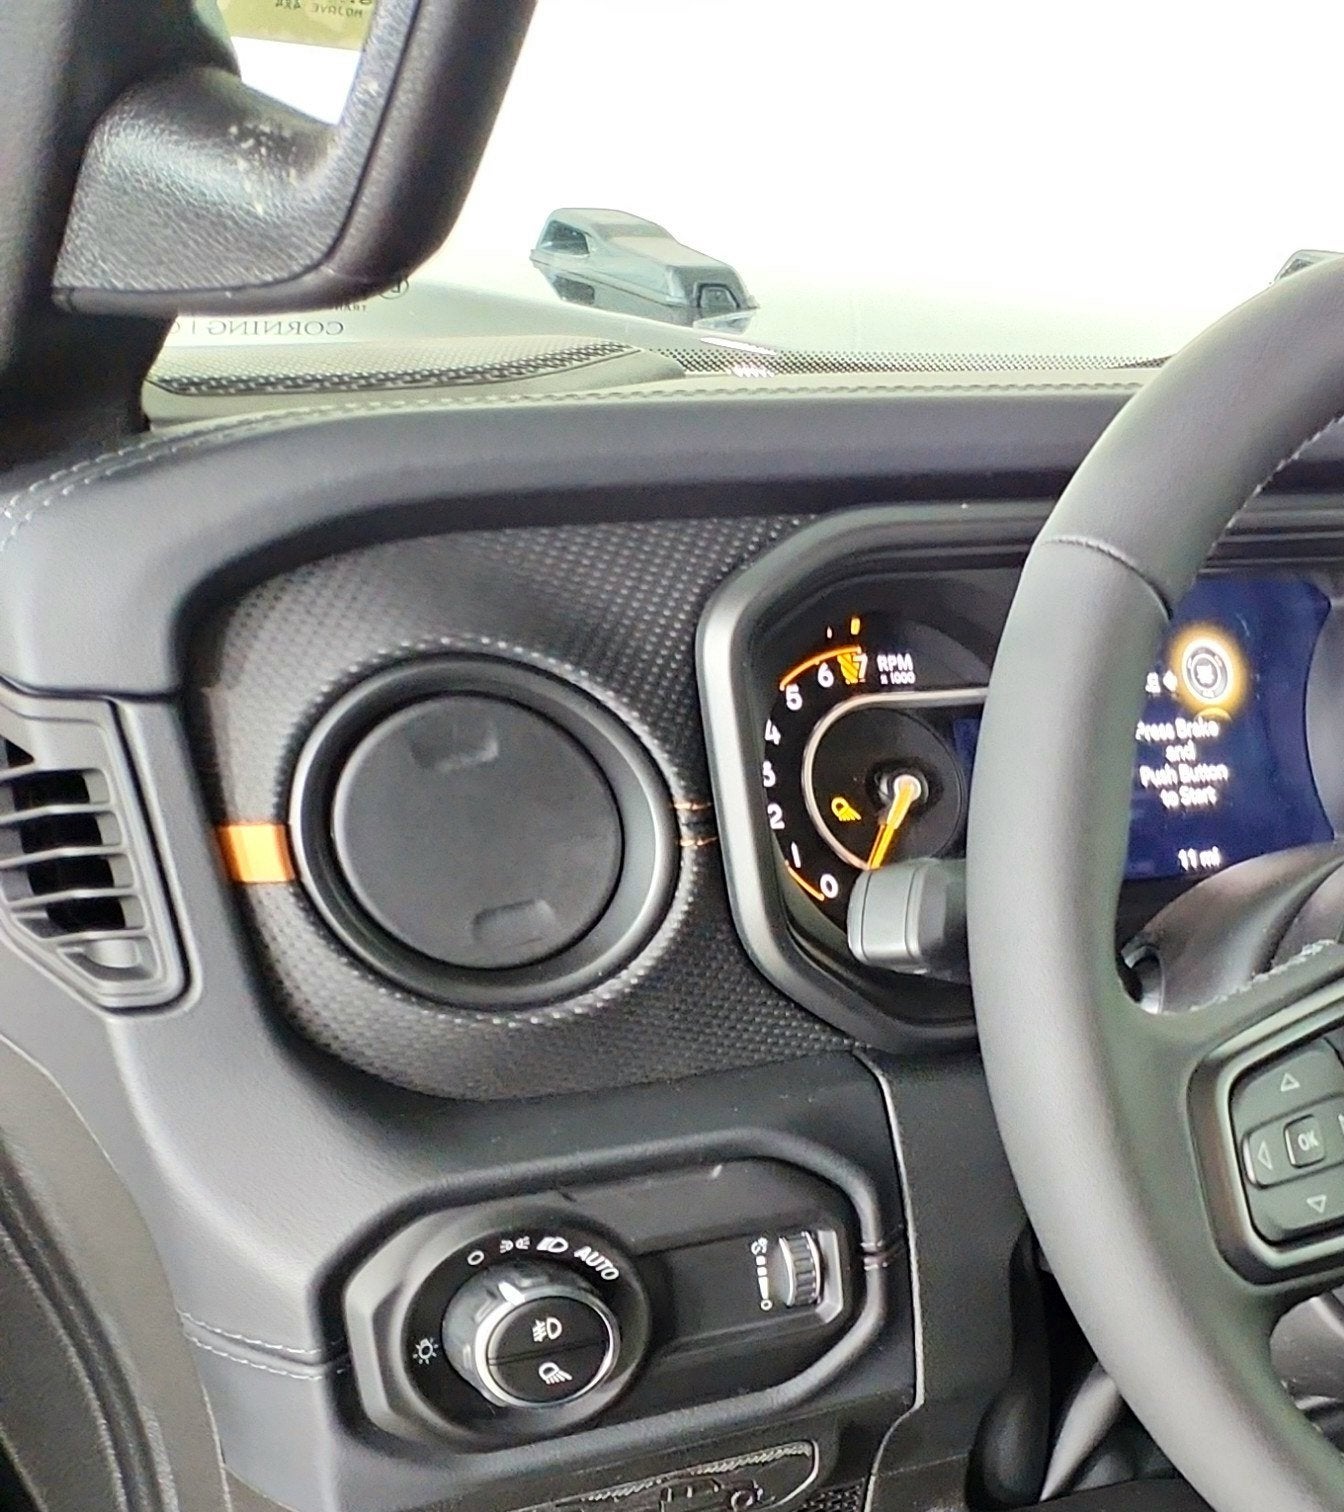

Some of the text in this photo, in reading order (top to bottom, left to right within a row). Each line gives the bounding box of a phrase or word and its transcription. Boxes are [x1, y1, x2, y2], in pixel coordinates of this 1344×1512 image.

[817, 662, 834, 688] 6
[852, 653, 868, 683] 7
[877, 653, 914, 672] RPM
[890, 671, 915, 684] 1000
[785, 684, 803, 711] 5
[764, 719, 781, 745] 4
[1174, 716, 1220, 739] Brake
[1165, 739, 1197, 762] and
[762, 760, 776, 787] 3
[1139, 763, 1229, 788] Push Button
[1159, 785, 1218, 809] to Start
[767, 803, 785, 829] 2
[791, 842, 801, 868] 1
[1177, 846, 1221, 871] 11 mi
[820, 873, 839, 898] 0
[1297, 1130, 1319, 1151] OK
[573, 1245, 620, 1281] AUTO
